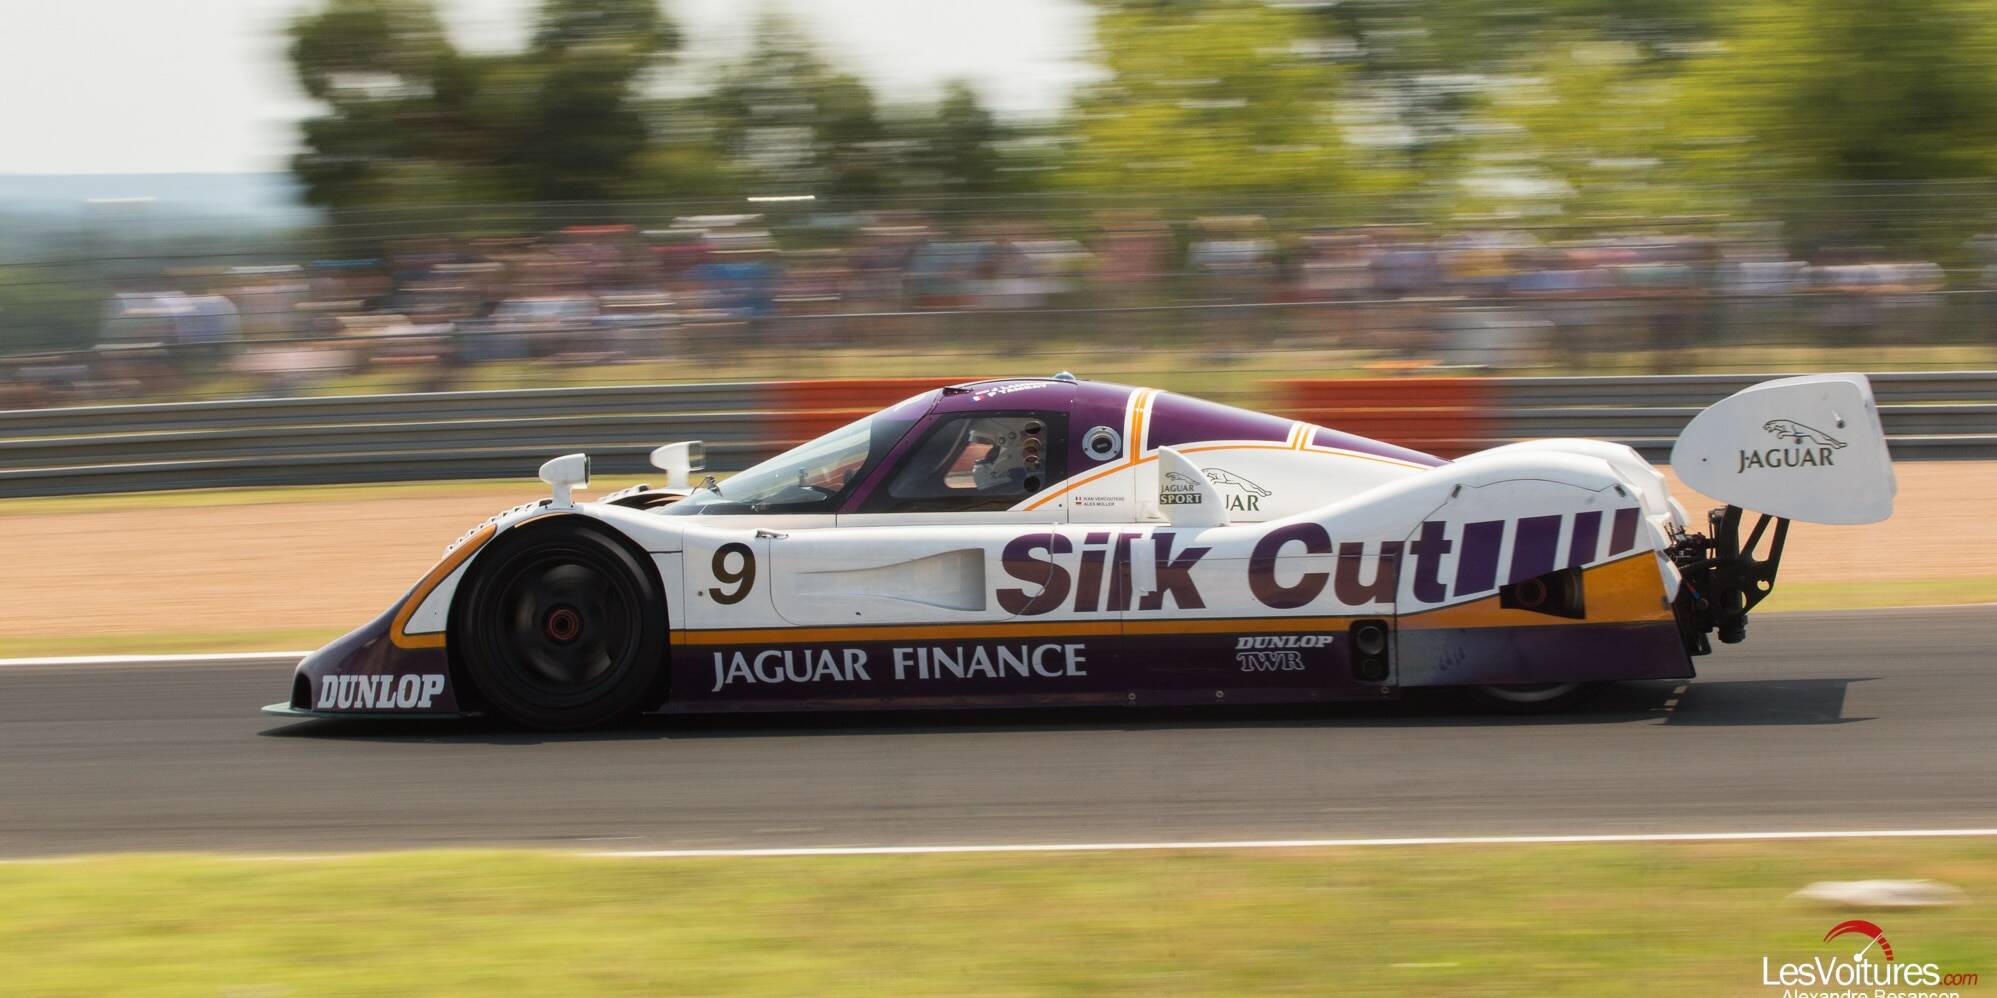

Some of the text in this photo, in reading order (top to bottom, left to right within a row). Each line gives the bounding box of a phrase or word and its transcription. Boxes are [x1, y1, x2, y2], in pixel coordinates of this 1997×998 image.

[1738, 448, 1835, 473] JAGUAR
[1160, 494, 1201, 504] SPORT
[1161, 484, 1194, 493] JAGUAR
[708, 542, 757, 605] 9
[995, 521, 1453, 616] Silk Cut
[1235, 635, 1334, 650] DUNLOP
[711, 643, 1088, 692] JAGUAR FINANCE
[1235, 651, 1305, 671] TWR
[316, 674, 446, 710] DUNLOP
